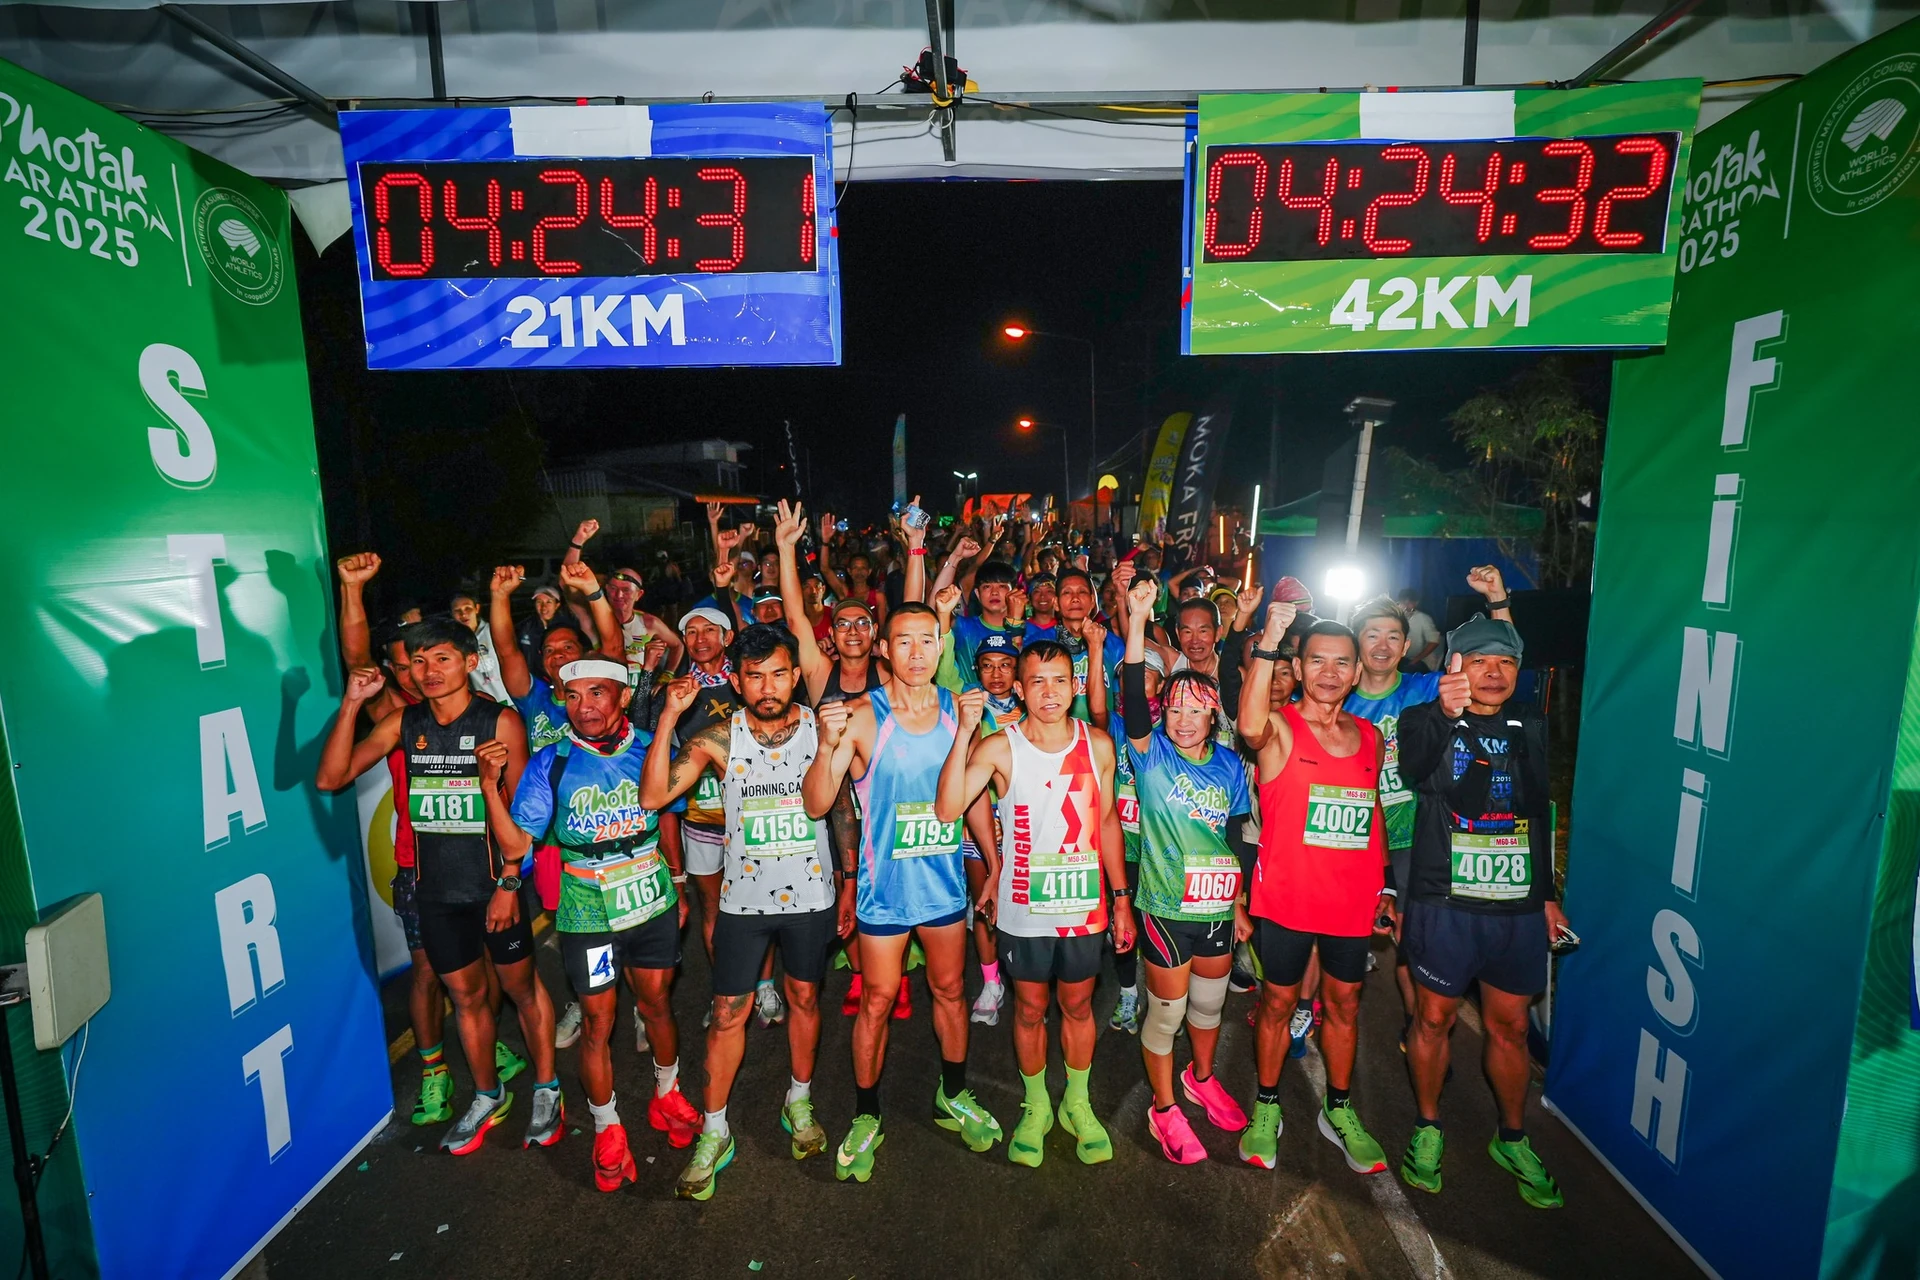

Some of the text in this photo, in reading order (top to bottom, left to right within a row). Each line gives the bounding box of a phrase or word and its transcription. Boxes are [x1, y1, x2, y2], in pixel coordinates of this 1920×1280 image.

[1812, 61, 1917, 194] CERTIFIED MEASURED COURSE
[1838, 152, 1898, 184] ATHLETICS
[1849, 145, 1889, 169] WORLD
[1857, 156, 1917, 207] cooperation
[4, 156, 175, 243] ARATHON
[1203, 137, 1668, 258] 04:24:32
[20, 196, 139, 267] 2025
[374, 167, 815, 277] 04:24:31
[1679, 220, 1740, 274] 025
[225, 262, 263, 281] ATHLETICS
[229, 255, 256, 270] WORLD
[244, 286, 275, 301] cooperation
[1329, 274, 1534, 332] 42KM
[505, 293, 686, 349] 21KM
[1181, 413, 1215, 504] MOKA
[138, 342, 294, 1165] START
[699, 777, 720, 797] 41
[741, 781, 802, 798] MORNING CA
[1346, 790, 1367, 798] M65-69
[1379, 768, 1402, 792] 45
[419, 794, 474, 820] 4181
[570, 778, 640, 816] Phota
[1121, 800, 1140, 822] 41
[593, 815, 647, 844] 2025
[751, 813, 808, 842] 4156
[901, 820, 955, 846] 4193
[1311, 803, 1369, 834] 4002
[1011, 804, 1032, 906] BUENGKAN
[1496, 838, 1518, 846] M60-64
[1067, 854, 1088, 863] M50-54
[1457, 853, 1526, 883] 4028
[615, 873, 661, 912] 4161
[1042, 870, 1088, 899] 4111
[1188, 873, 1237, 900] 4060
[591, 950, 611, 977] 4
